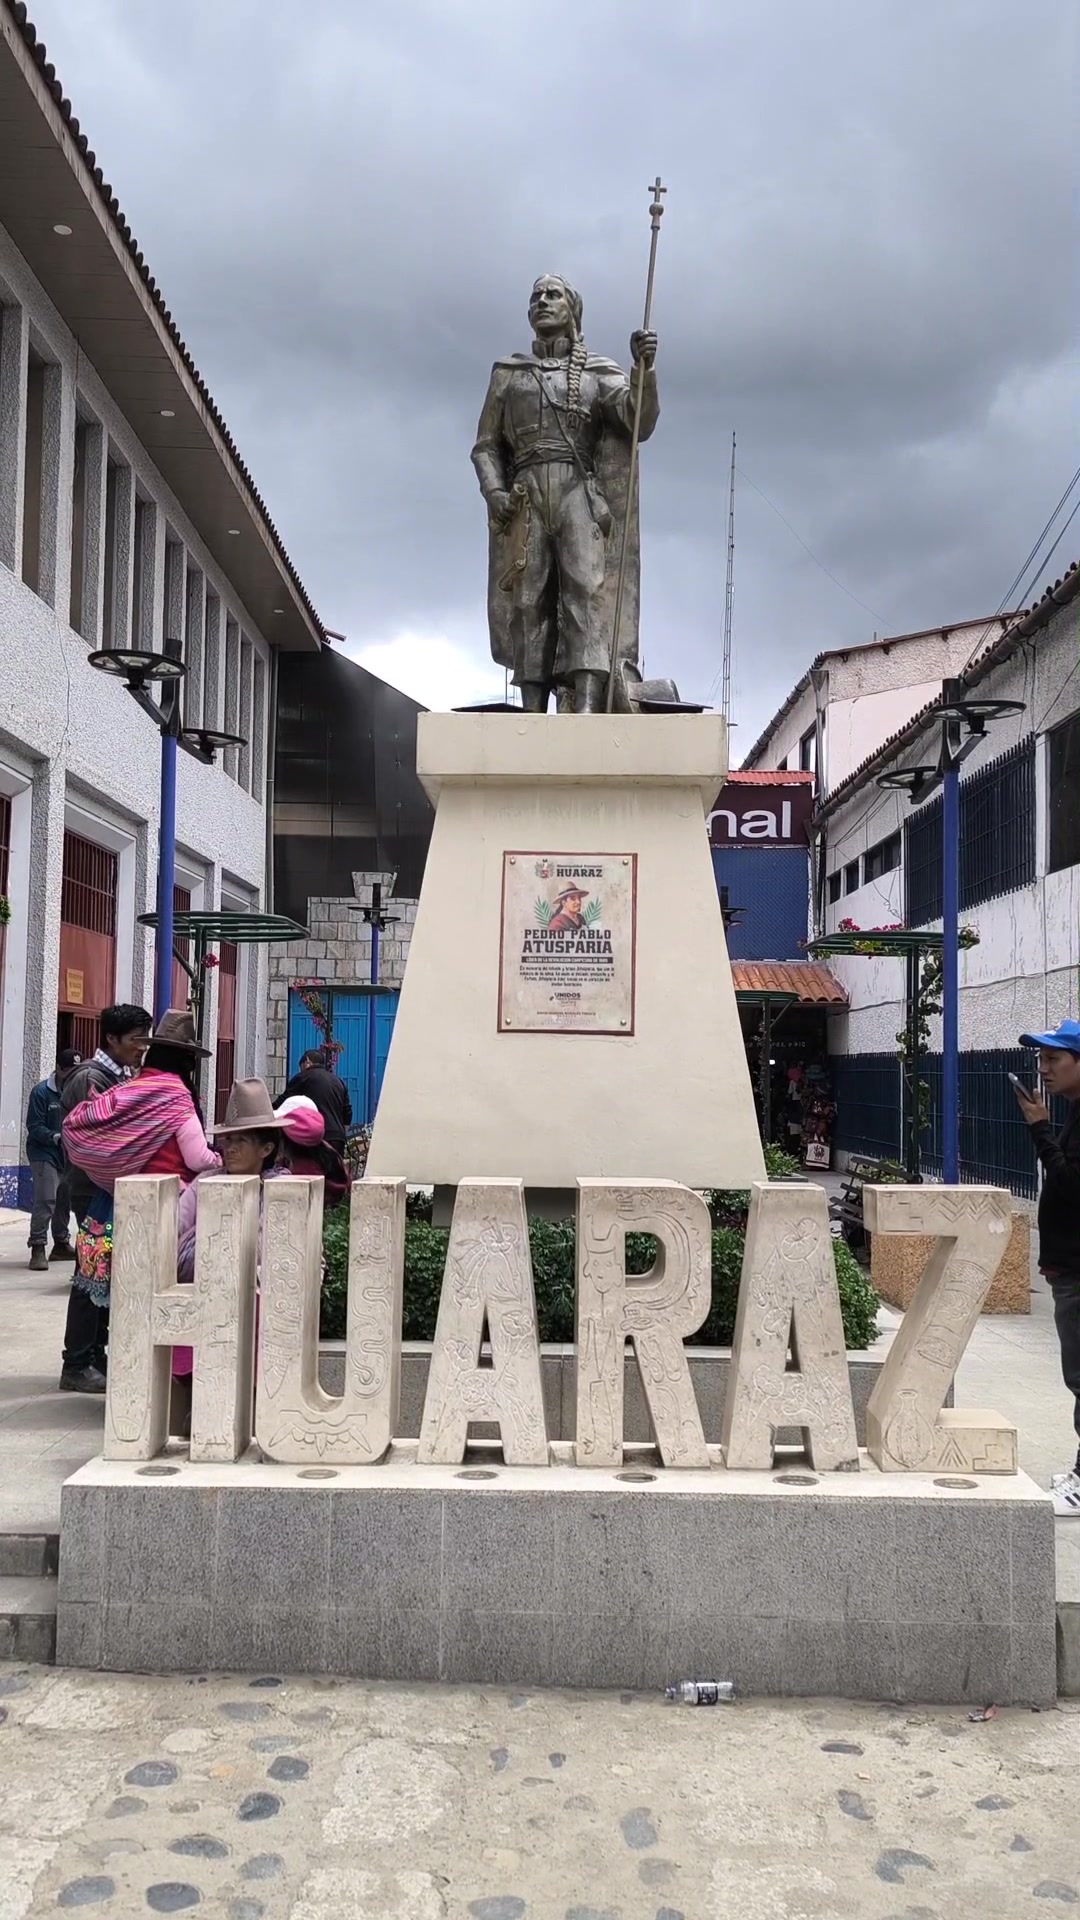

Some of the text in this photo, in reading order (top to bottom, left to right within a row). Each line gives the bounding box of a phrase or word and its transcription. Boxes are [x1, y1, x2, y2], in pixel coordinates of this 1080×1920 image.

[556, 868, 603, 878] HUARAZ
[524, 929, 612, 940] PEDRO PABLO
[522, 940, 613, 954] ATUSPARIA
[104, 1175, 1018, 1475] HUARAZ
